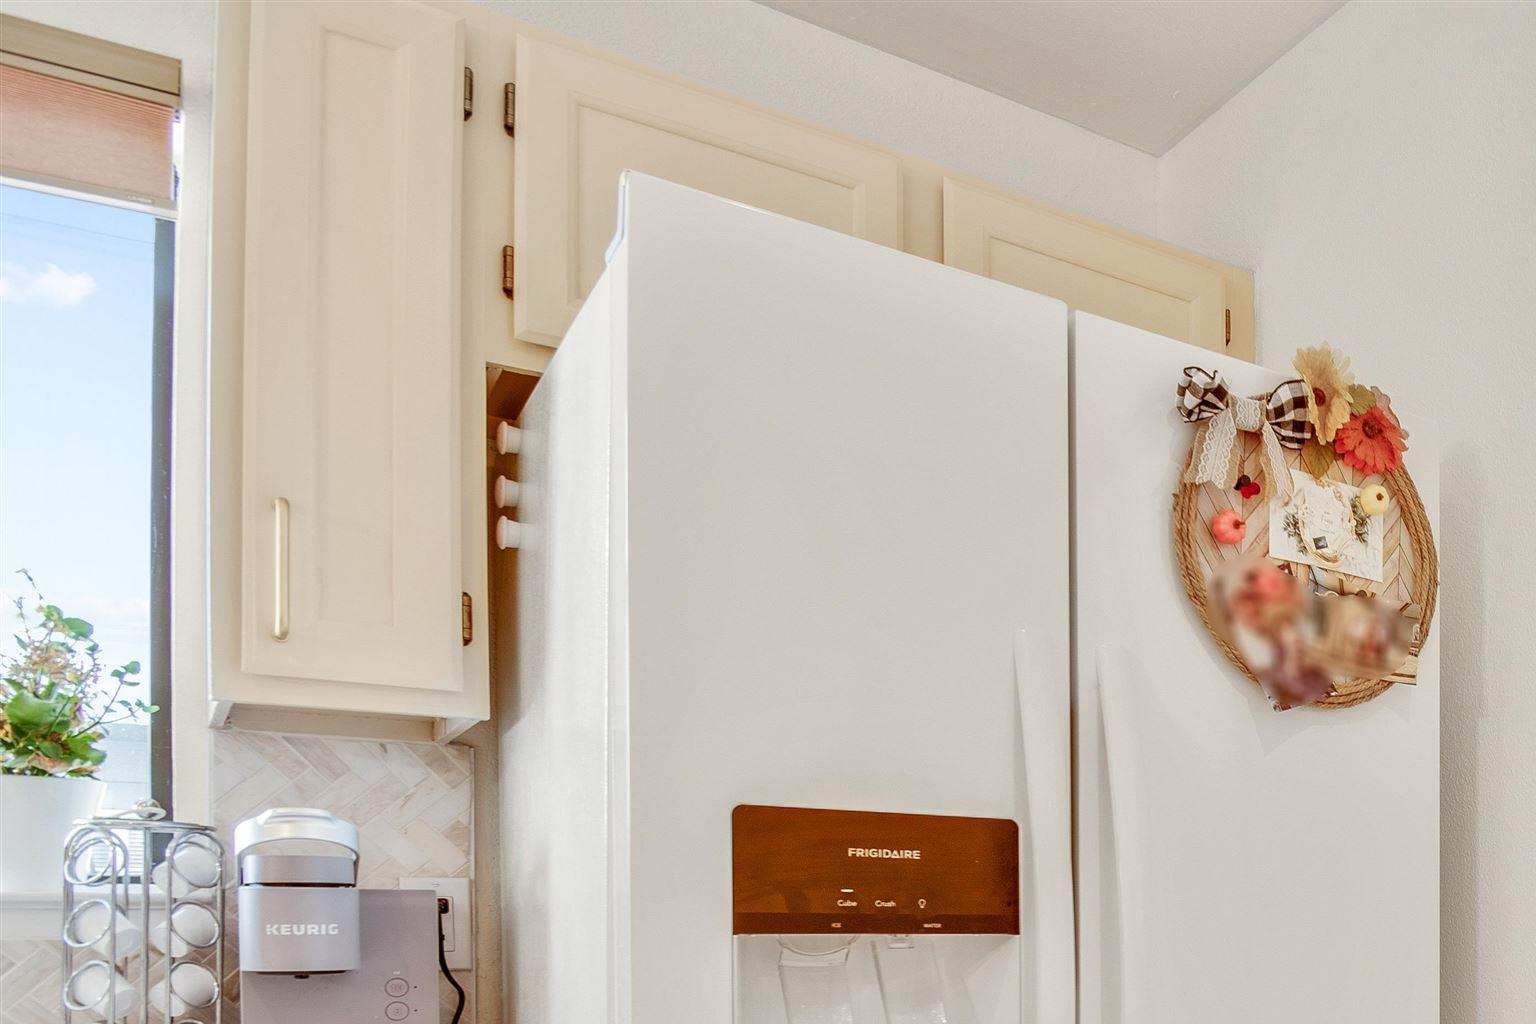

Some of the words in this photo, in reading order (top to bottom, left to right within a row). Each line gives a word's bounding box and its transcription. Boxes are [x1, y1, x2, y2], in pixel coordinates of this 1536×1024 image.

[847, 847, 921, 860] FRIGIDAIRE
[837, 899, 858, 907] Cube
[875, 899, 896, 907] Crush
[265, 922, 340, 936] KEURIG
